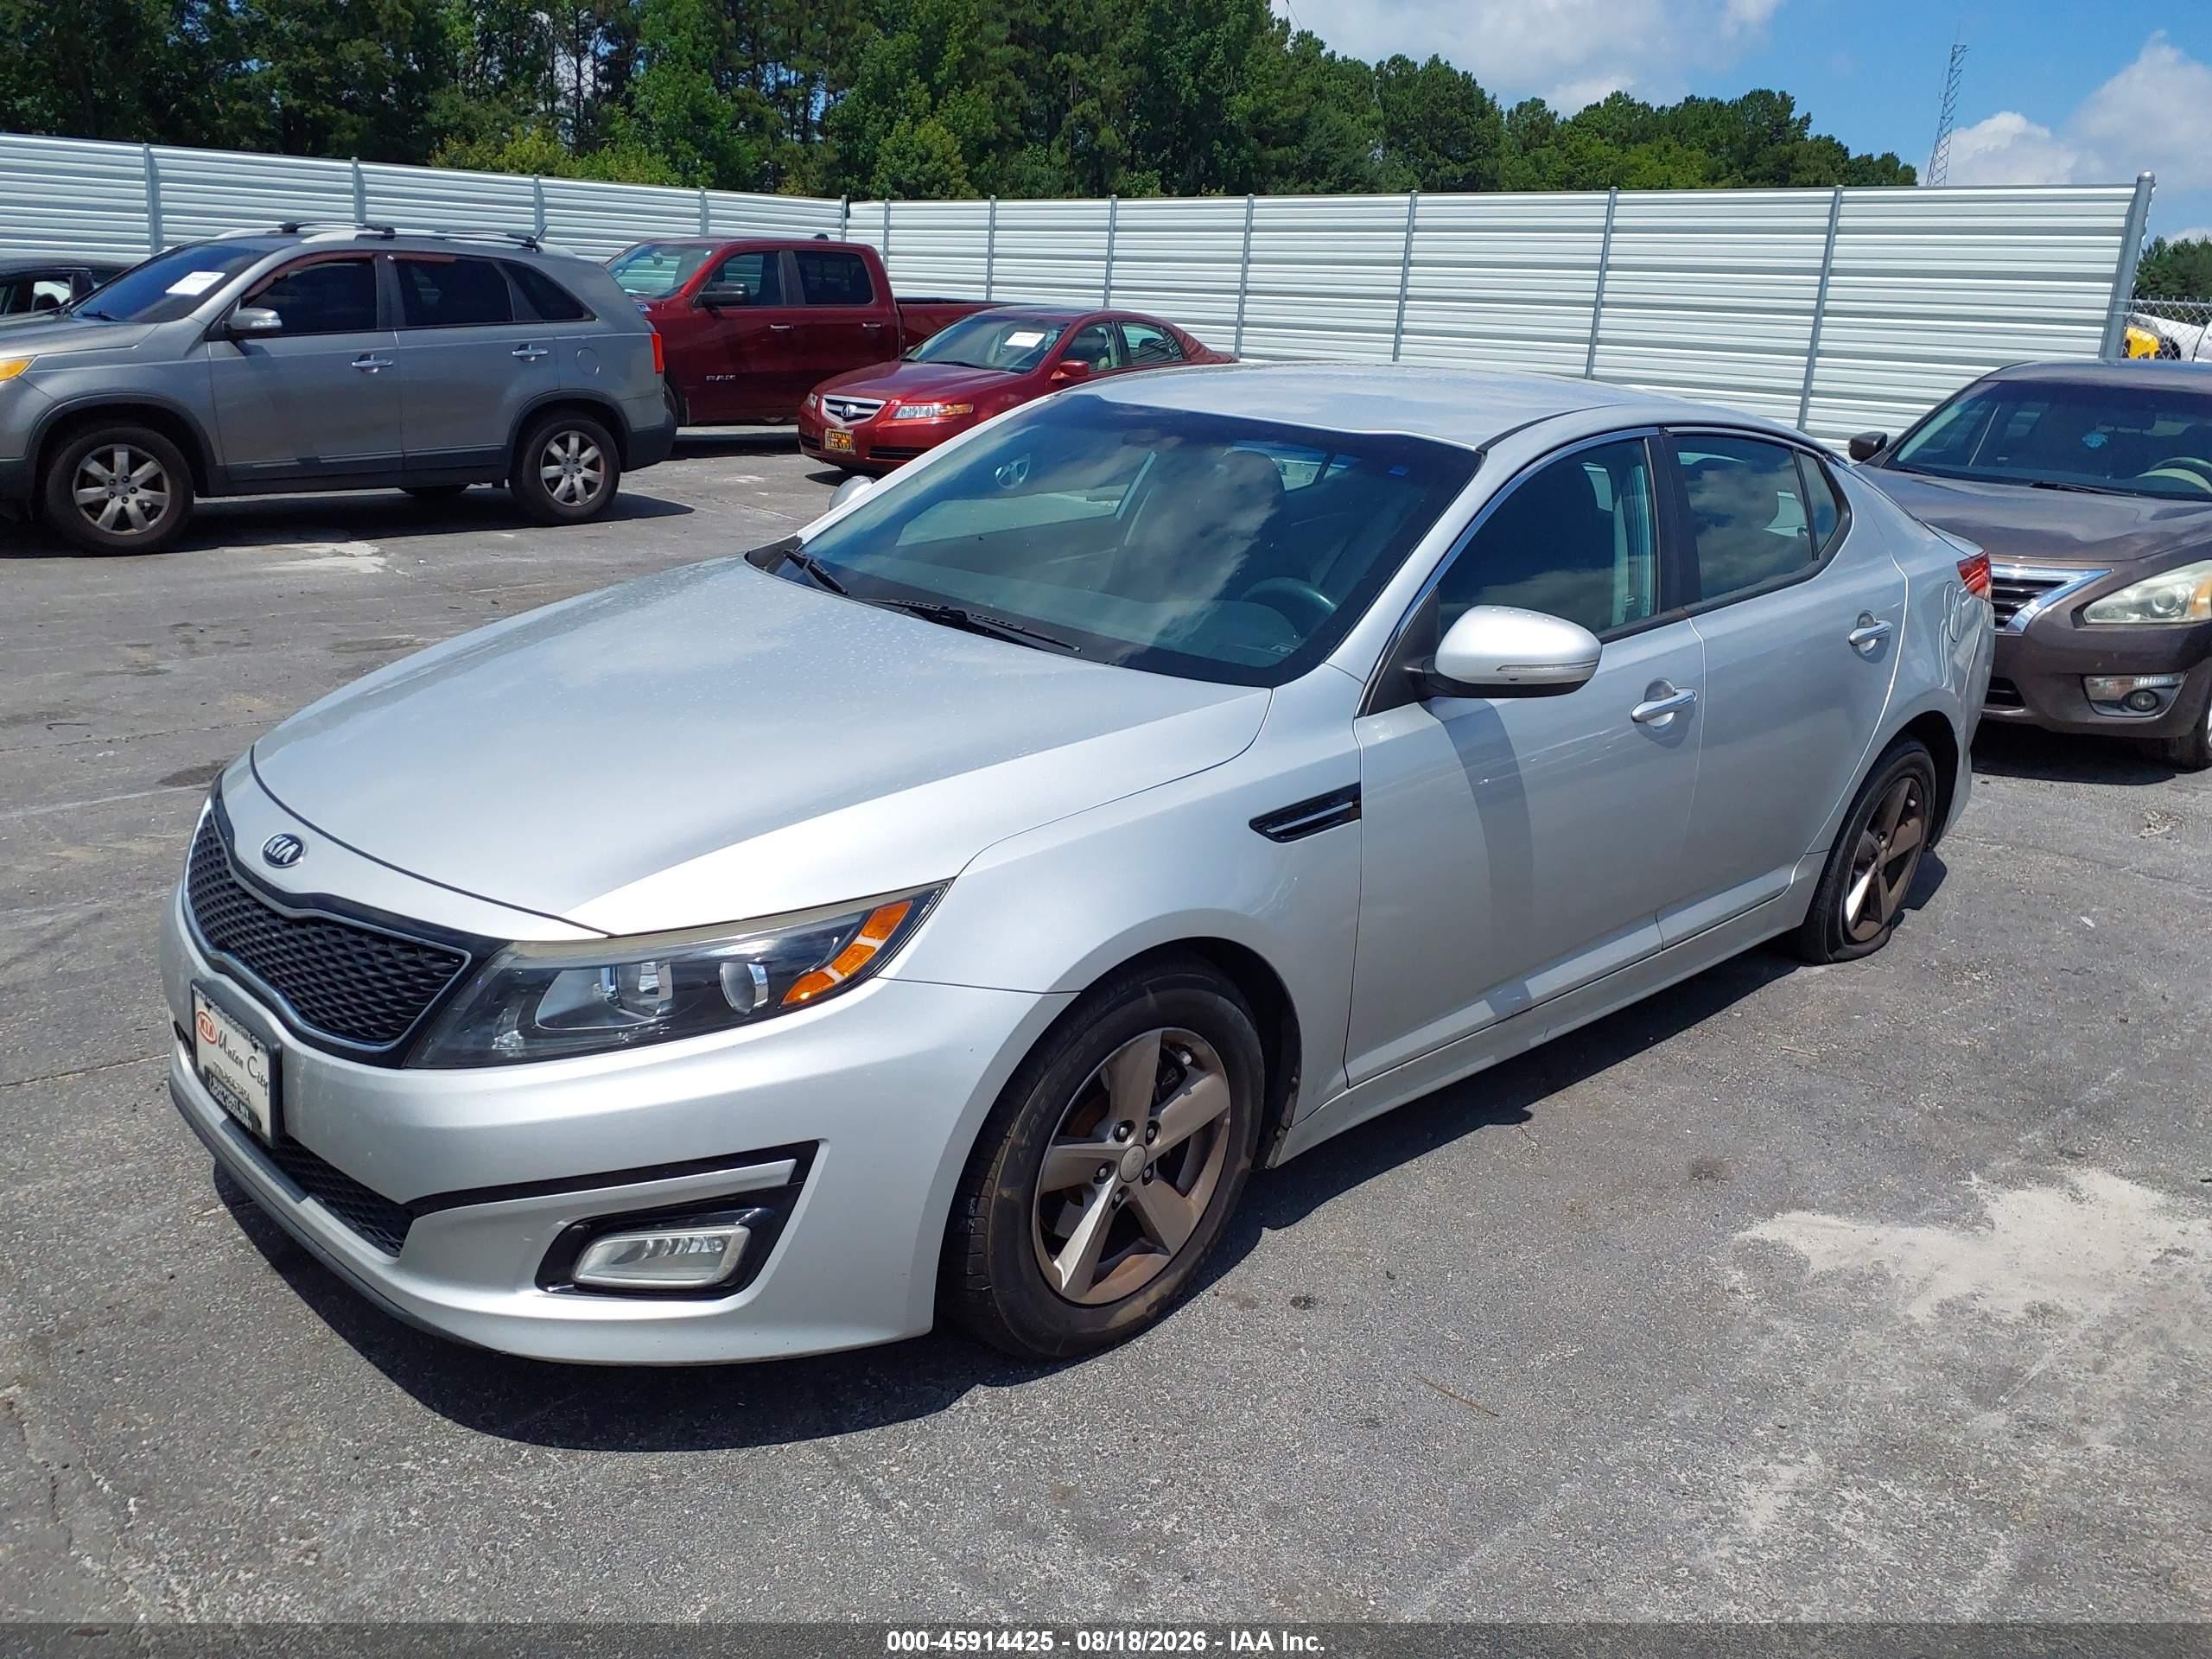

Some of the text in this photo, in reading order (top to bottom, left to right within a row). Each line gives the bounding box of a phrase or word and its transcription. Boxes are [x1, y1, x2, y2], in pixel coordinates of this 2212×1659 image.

[264, 835, 300, 864] KIA
[218, 1029, 244, 1070] Union
[247, 1055, 269, 1096] City
